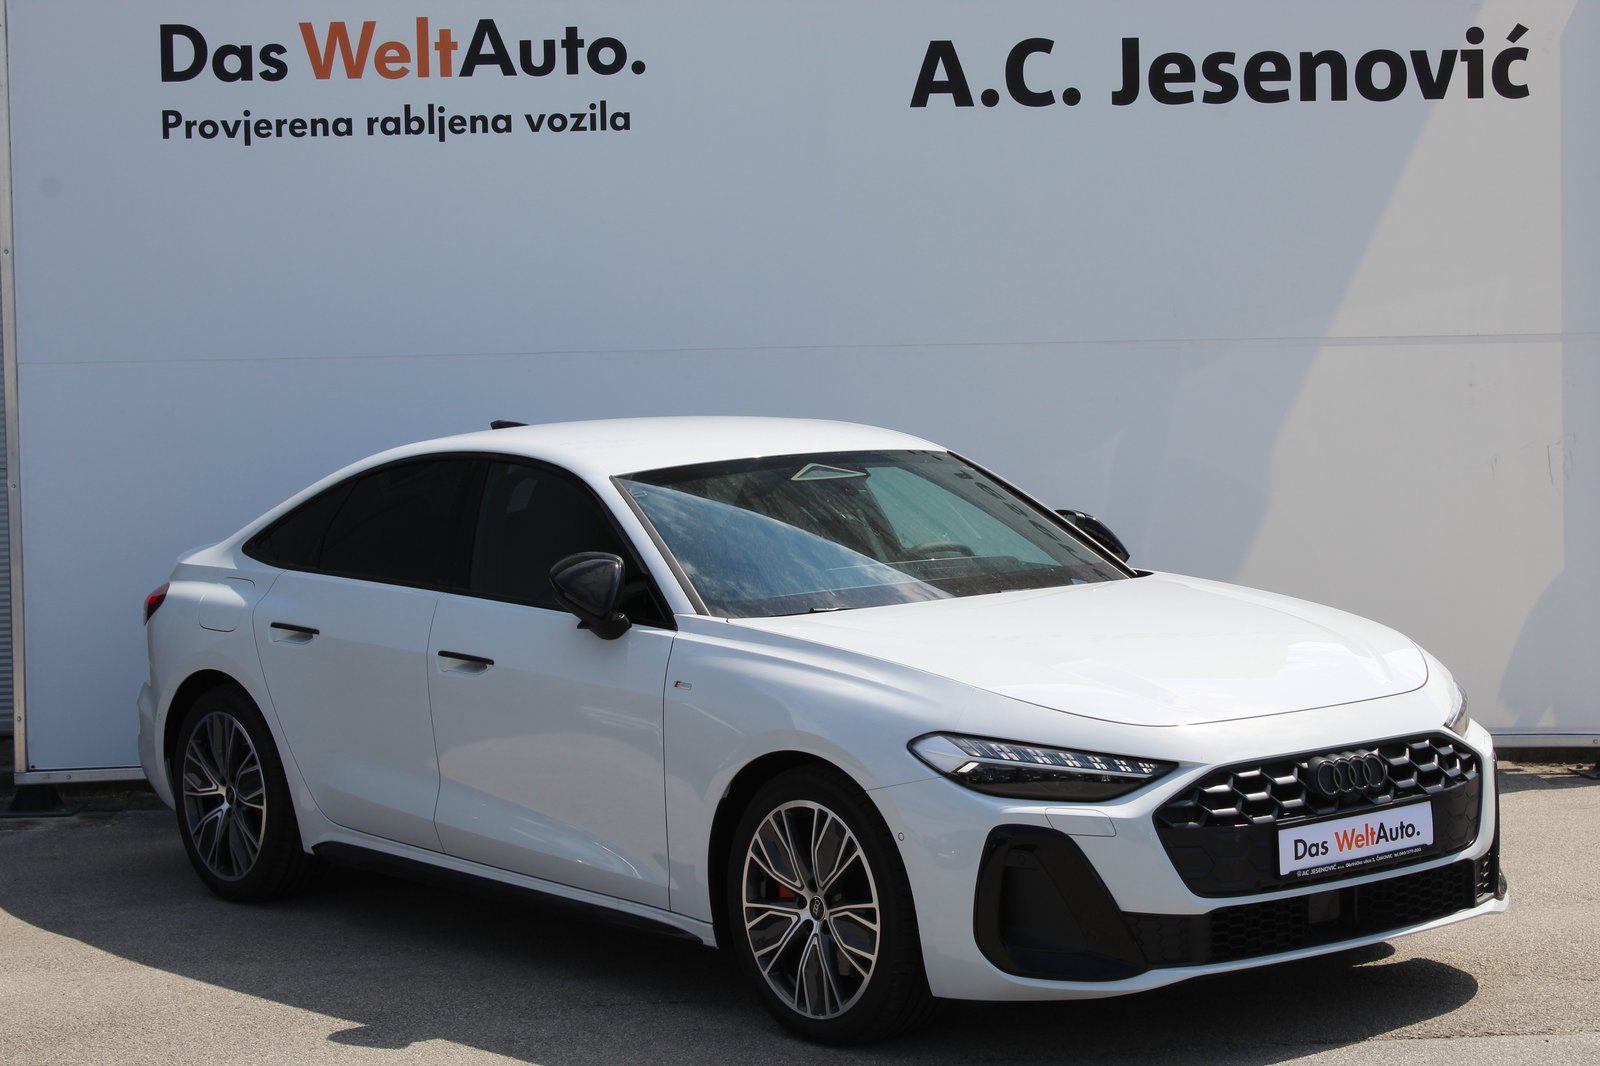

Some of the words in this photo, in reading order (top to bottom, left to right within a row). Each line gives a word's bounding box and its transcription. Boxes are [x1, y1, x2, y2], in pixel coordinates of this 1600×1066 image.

[160, 24, 289, 83] Das
[299, 15, 647, 80] WeltAuto.
[910, 38, 1082, 108] A.C.
[1112, 22, 1530, 107] Jesenović
[162, 109, 353, 147] Provjerena
[366, 104, 513, 143] rabljena
[525, 99, 632, 134] vozila
[1294, 839, 1329, 861] Das
[1334, 821, 1421, 853] WeltAuto.
